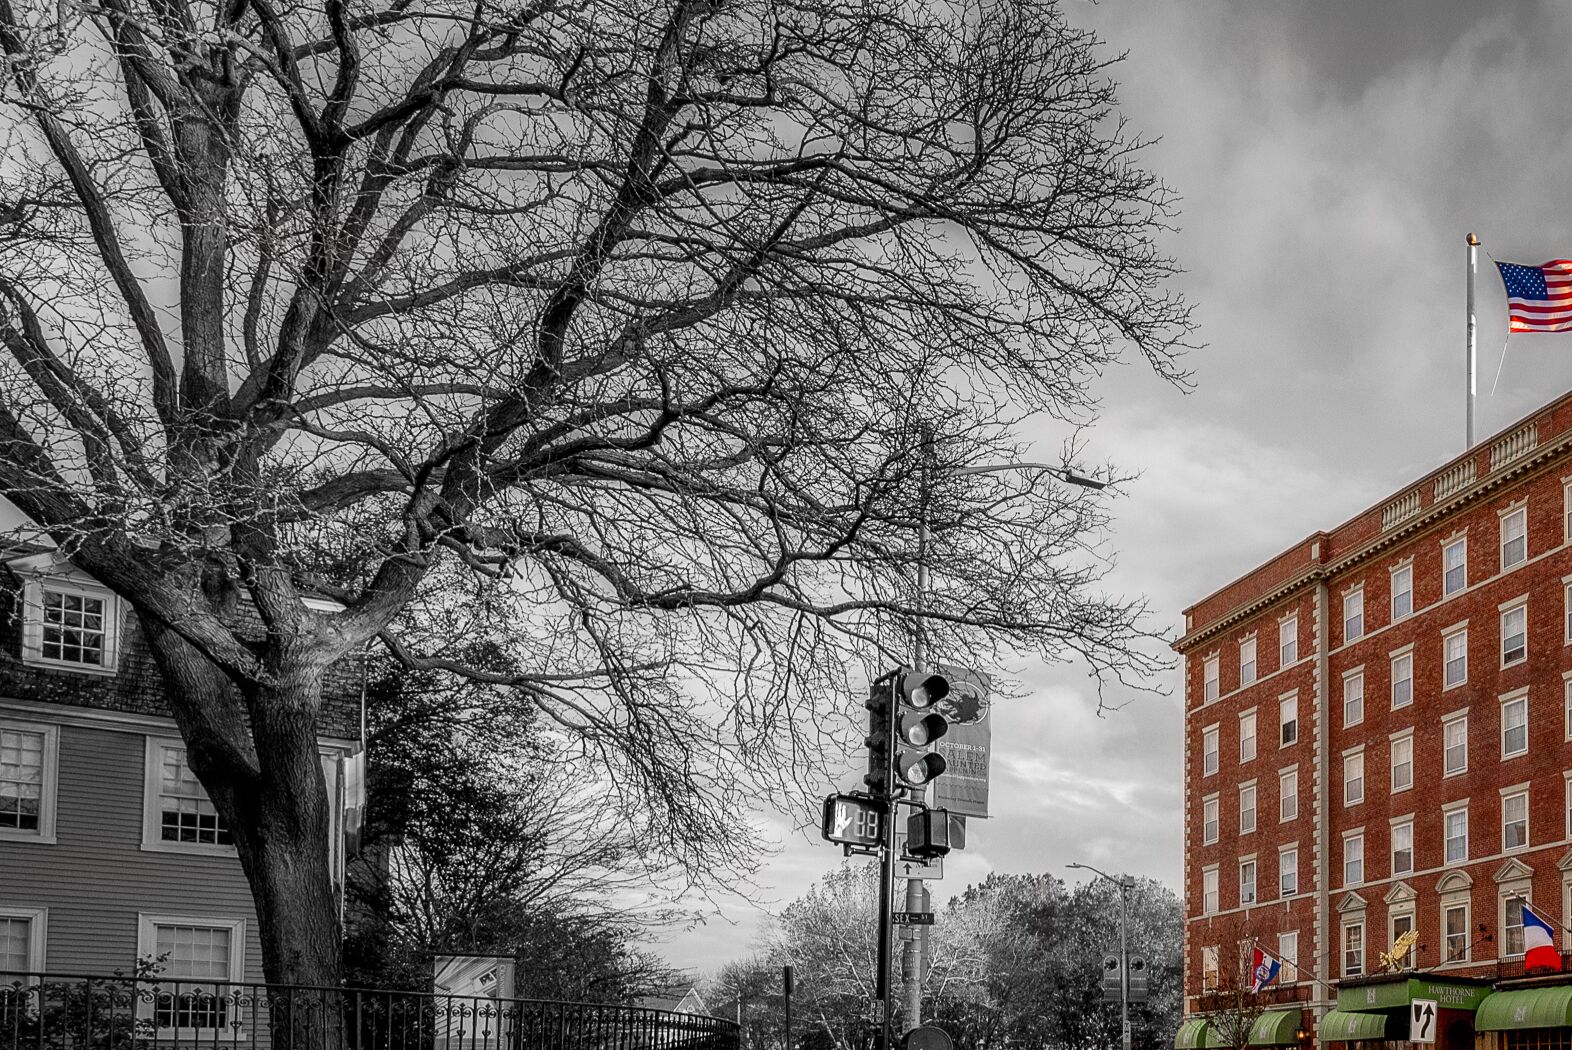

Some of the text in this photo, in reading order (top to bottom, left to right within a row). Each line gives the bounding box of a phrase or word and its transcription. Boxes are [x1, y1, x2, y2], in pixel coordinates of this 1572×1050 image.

[940, 741, 972, 751] OCTOBER
[939, 747, 986, 762] SALEM
[946, 759, 987, 771] AUNTED
[892, 913, 910, 924] SEX
[1428, 985, 1475, 998] HAWTHORNE
[1440, 994, 1464, 1005] HOTEL
